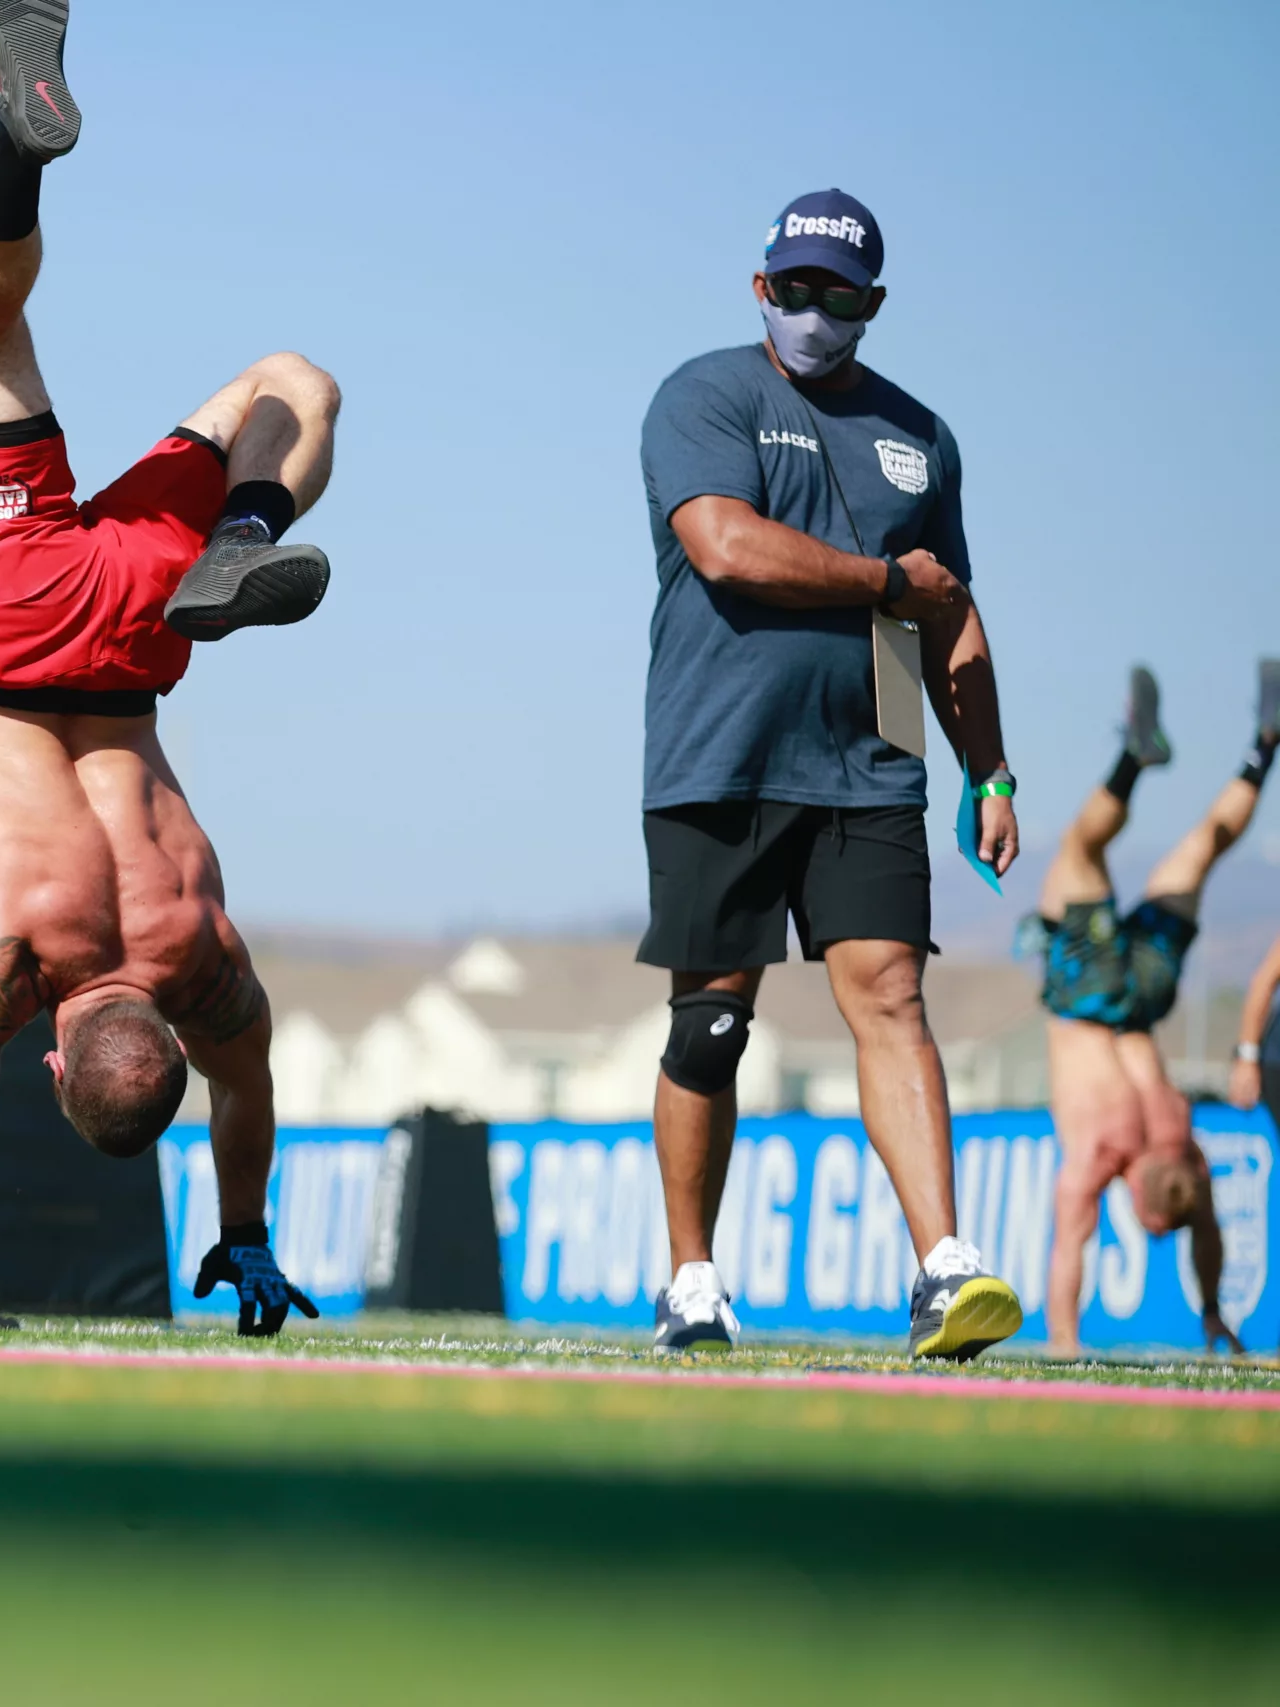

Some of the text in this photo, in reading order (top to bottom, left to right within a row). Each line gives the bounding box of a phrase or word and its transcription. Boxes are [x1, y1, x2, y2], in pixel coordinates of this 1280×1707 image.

[785, 213, 866, 248] CrossFit
[885, 460, 925, 482] GAMES
[521, 1134, 798, 1309] PROVNG
